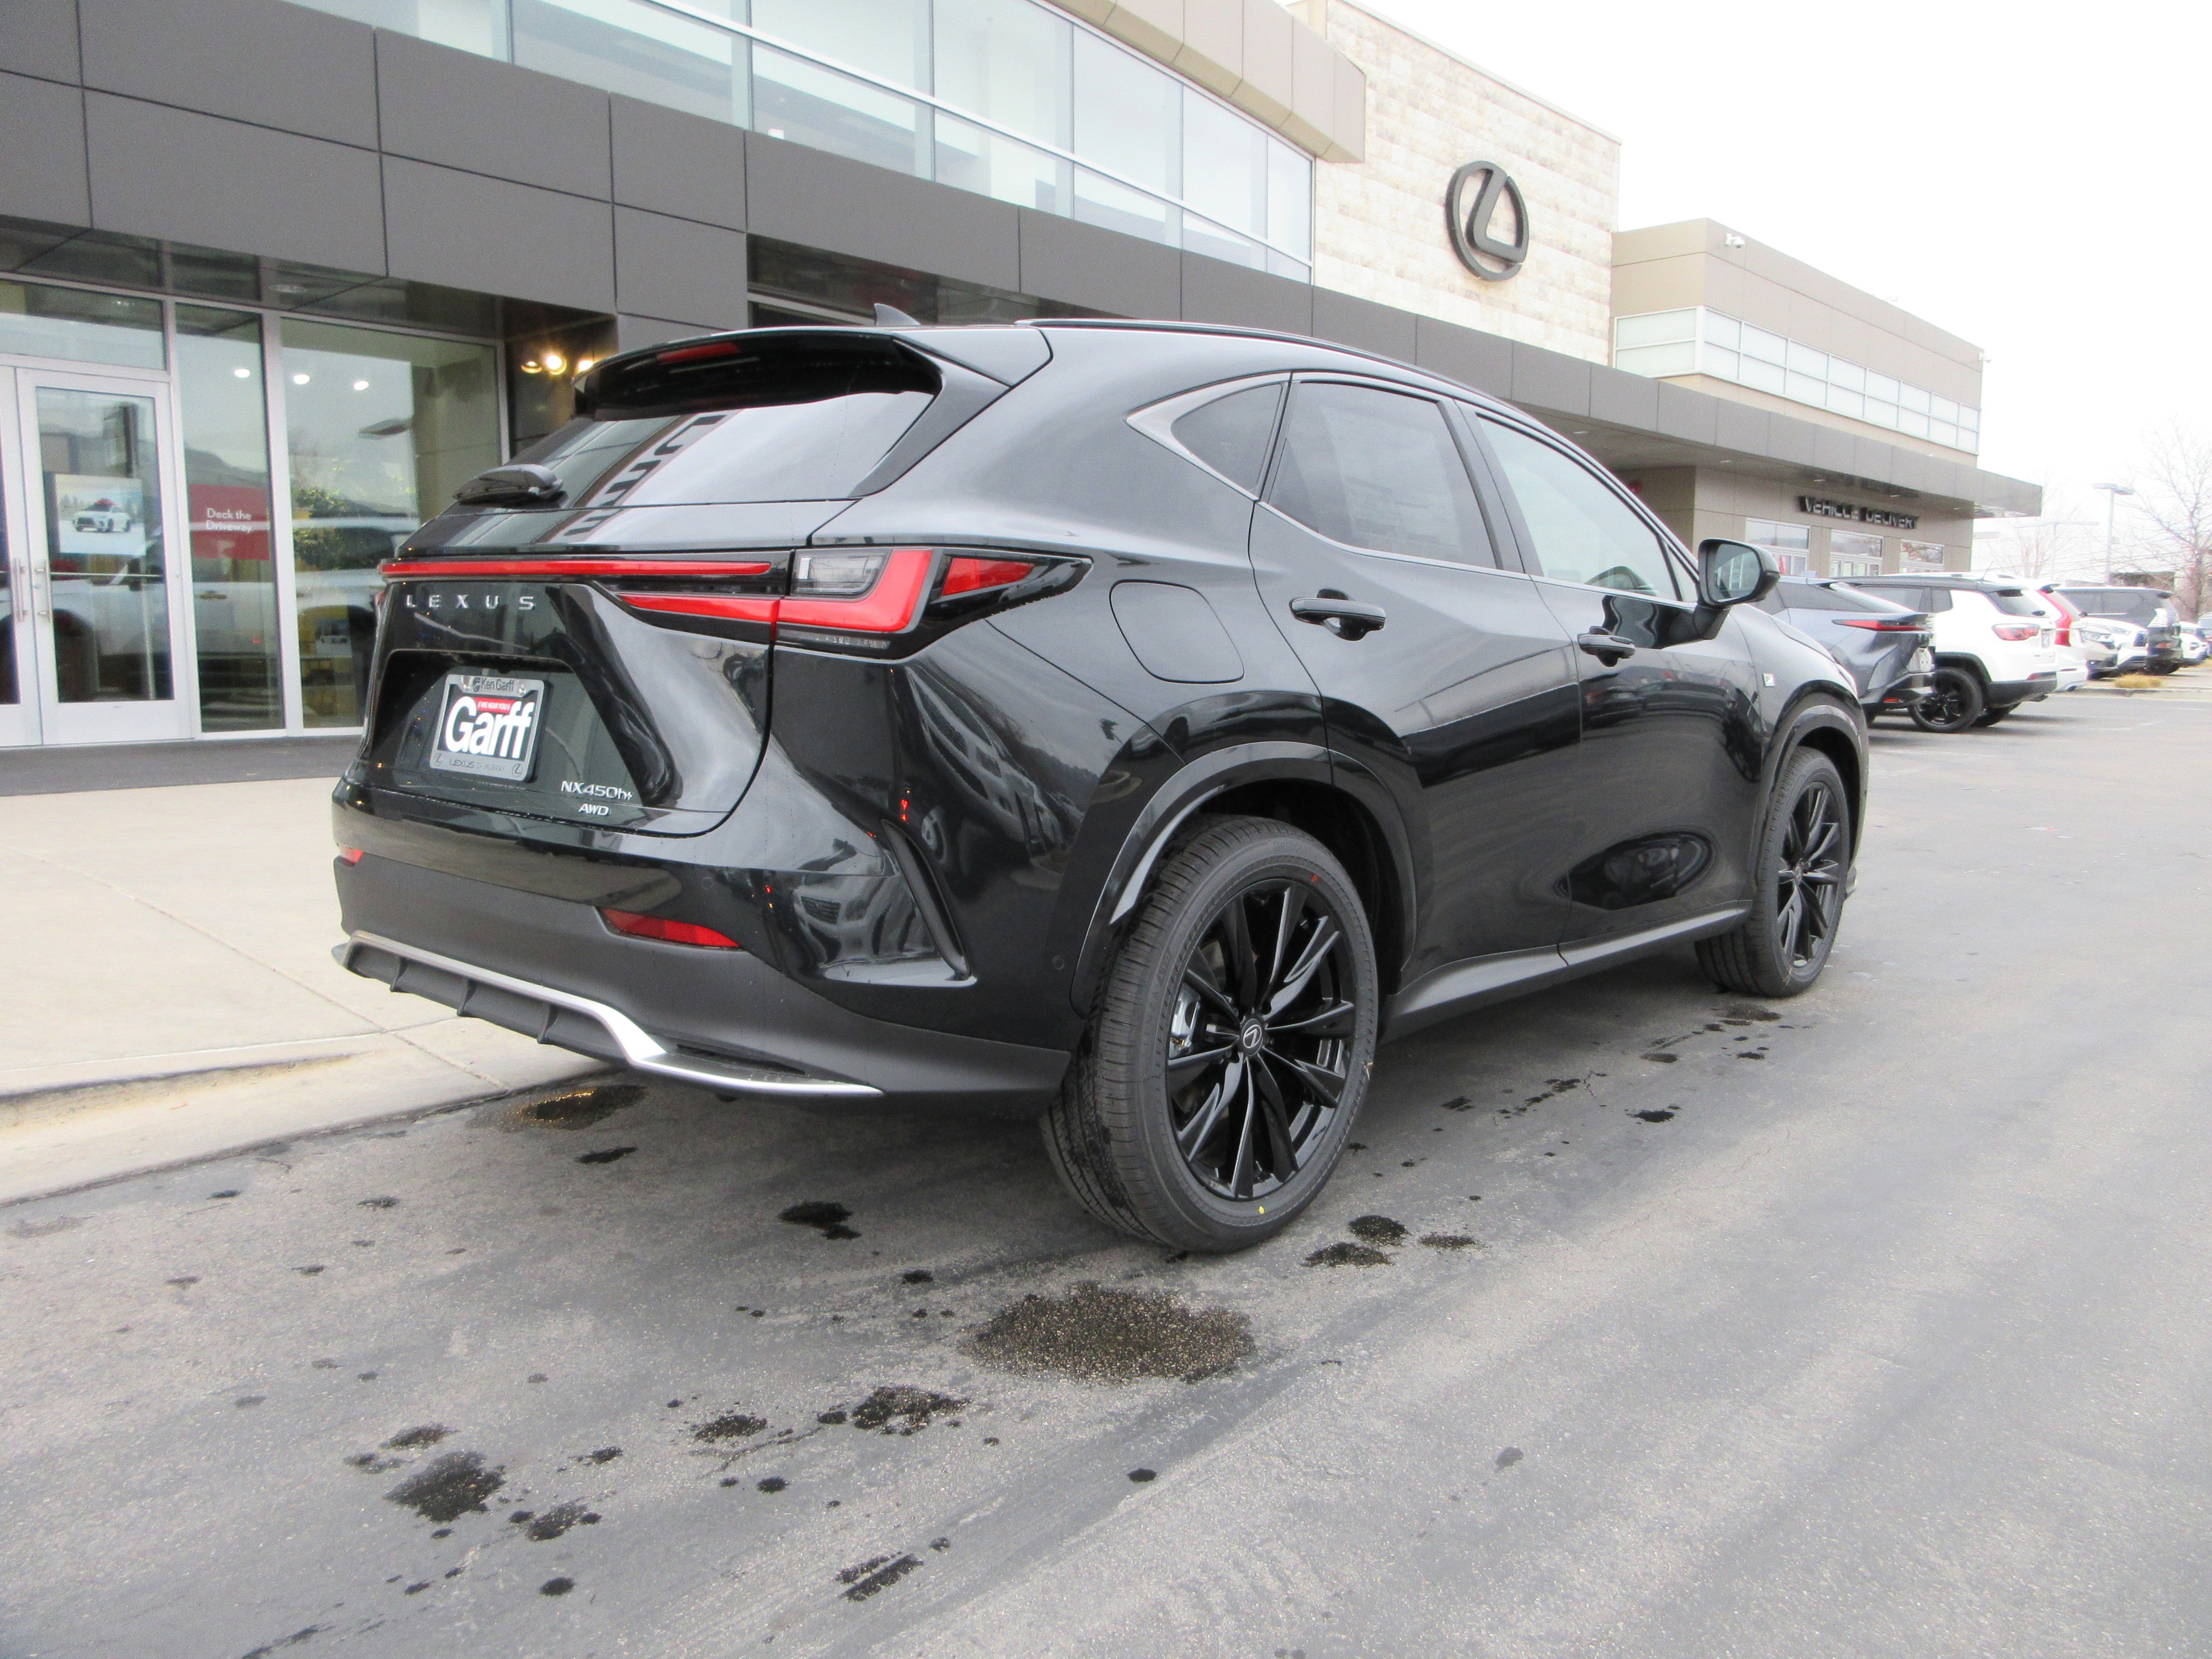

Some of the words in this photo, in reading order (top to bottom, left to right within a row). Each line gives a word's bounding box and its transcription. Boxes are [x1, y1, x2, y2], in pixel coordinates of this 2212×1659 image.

[207, 507, 233, 519] Deck
[236, 509, 252, 520] the
[1799, 495, 1860, 520] VEHICLE
[405, 594, 535, 610] LEXUS
[481, 677, 495, 690] Ken
[496, 678, 515, 691] Garff
[445, 696, 535, 759] Garff
[561, 780, 632, 800] NX450h+
[578, 803, 609, 816] AWD
